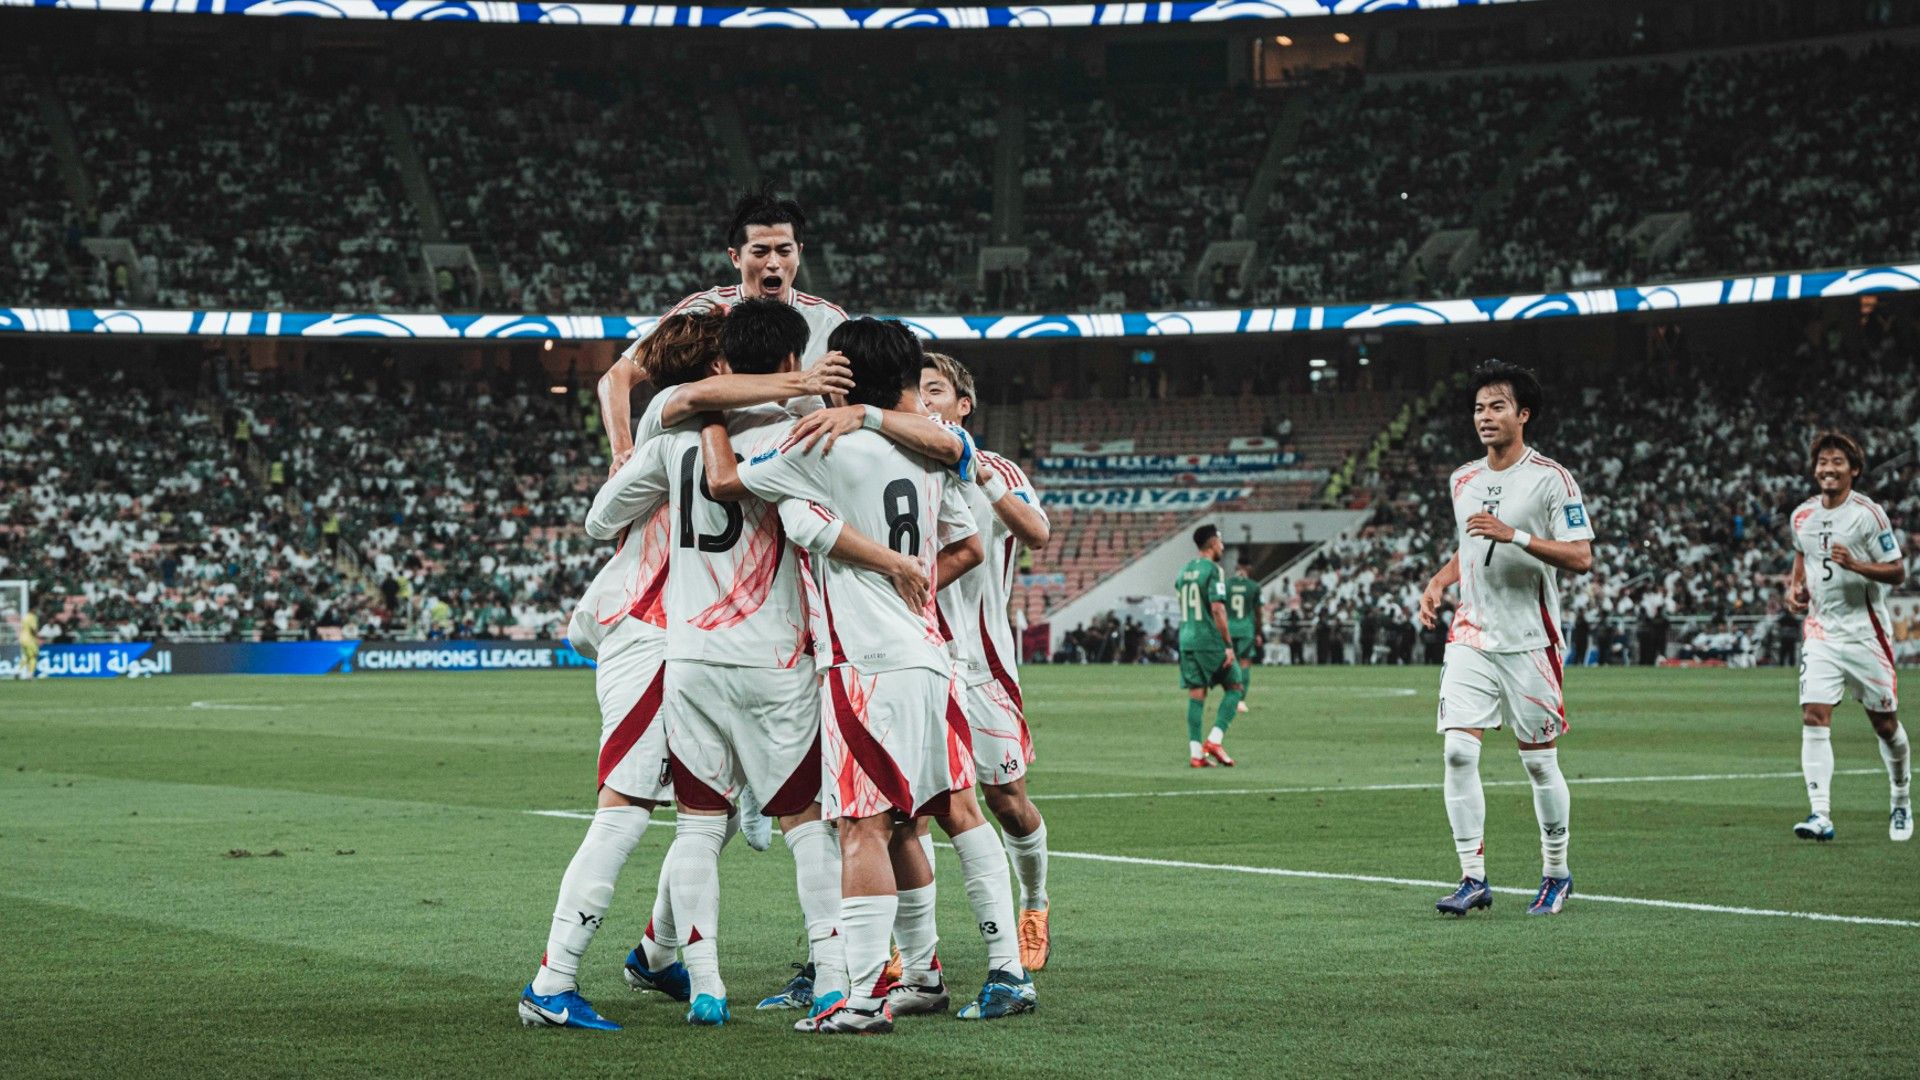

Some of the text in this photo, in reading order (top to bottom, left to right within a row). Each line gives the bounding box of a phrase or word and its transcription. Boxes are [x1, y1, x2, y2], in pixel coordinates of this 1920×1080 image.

[680, 446, 744, 553] 15
[1041, 487, 1243, 505] MORIYASU
[1487, 486, 1502, 496] Y-3
[883, 478, 920, 557] 8
[1822, 557, 1833, 581] 5
[1231, 594, 1245, 619] 9
[36, 650, 101, 679] الثالثة
[106, 650, 172, 678] الجولة
[365, 650, 477, 668] CHAMPIONS
[481, 649, 552, 667] LEAGUE
[1000, 759, 1018, 774] Y-3
[1543, 826, 1567, 837] Y-3
